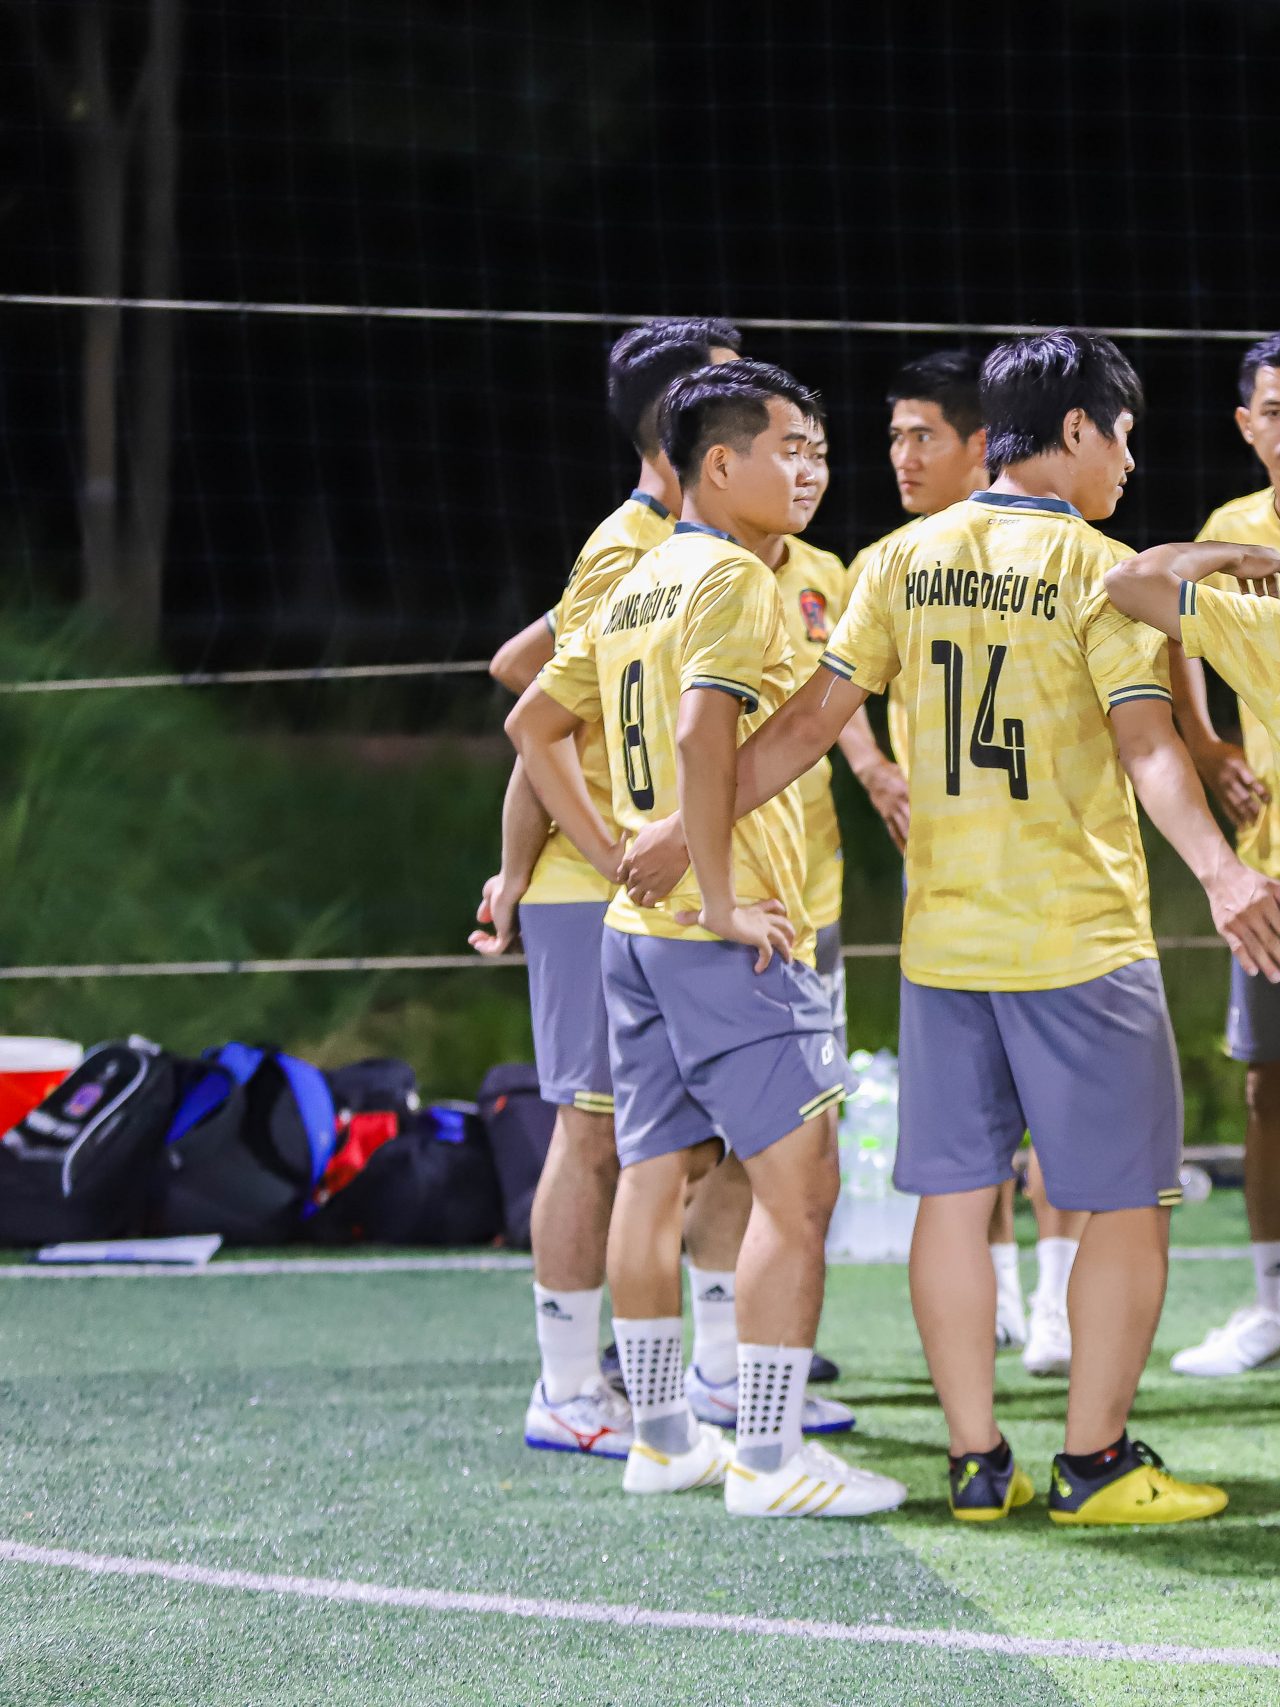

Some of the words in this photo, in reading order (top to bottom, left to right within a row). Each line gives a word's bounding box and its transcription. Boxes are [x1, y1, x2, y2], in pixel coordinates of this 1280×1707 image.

[660, 583, 683, 620] FC
[1031, 579, 1059, 621] FC
[620, 658, 655, 811] 8
[931, 639, 1029, 800] 14
